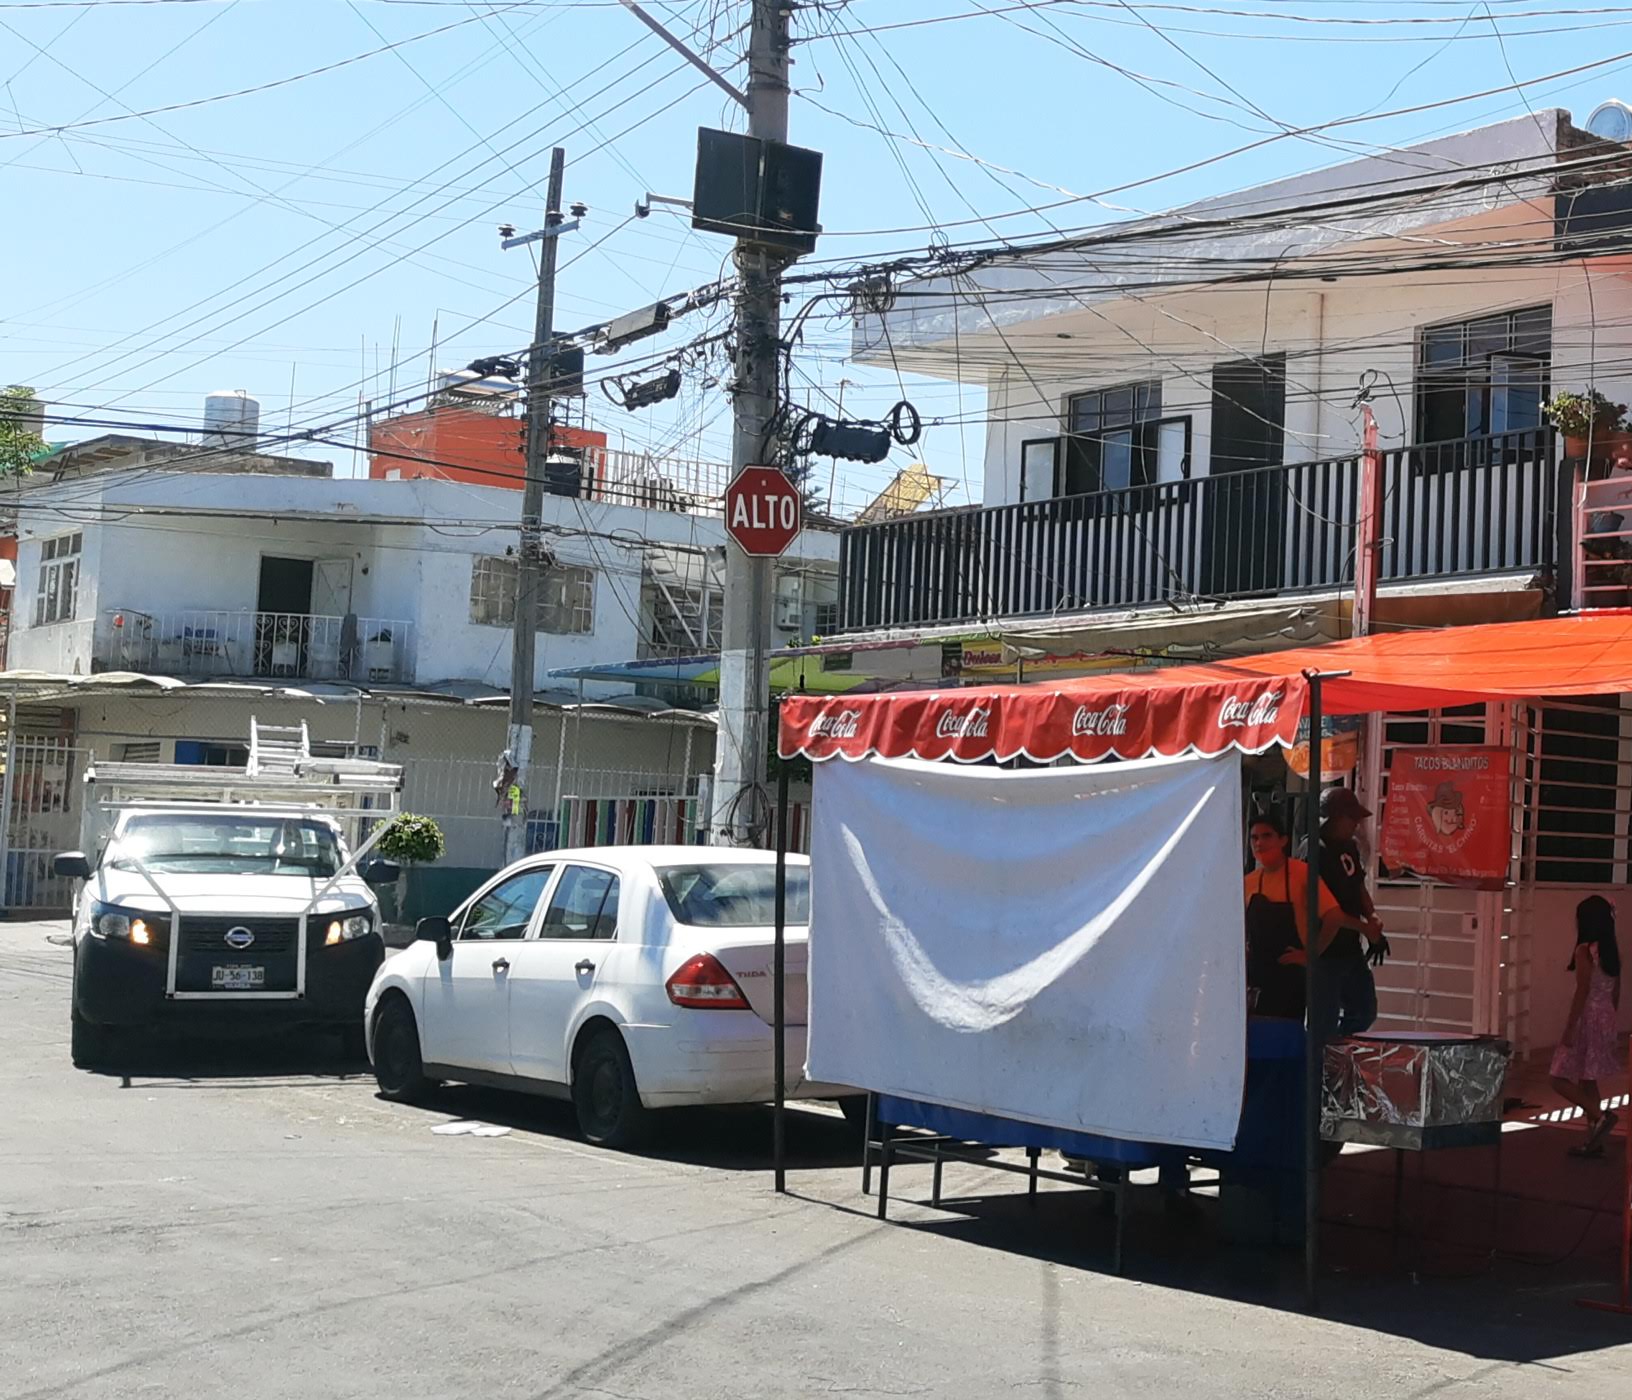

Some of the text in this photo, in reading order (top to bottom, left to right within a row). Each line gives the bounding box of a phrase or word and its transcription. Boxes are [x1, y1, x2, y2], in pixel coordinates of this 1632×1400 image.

[732, 493, 795, 530] ALTO
[808, 710, 862, 738] Coca-Cola
[1072, 703, 1131, 737] Coca-Cola
[1217, 691, 1284, 728] Coca-Cola
[1414, 756, 1440, 770] TACOS
